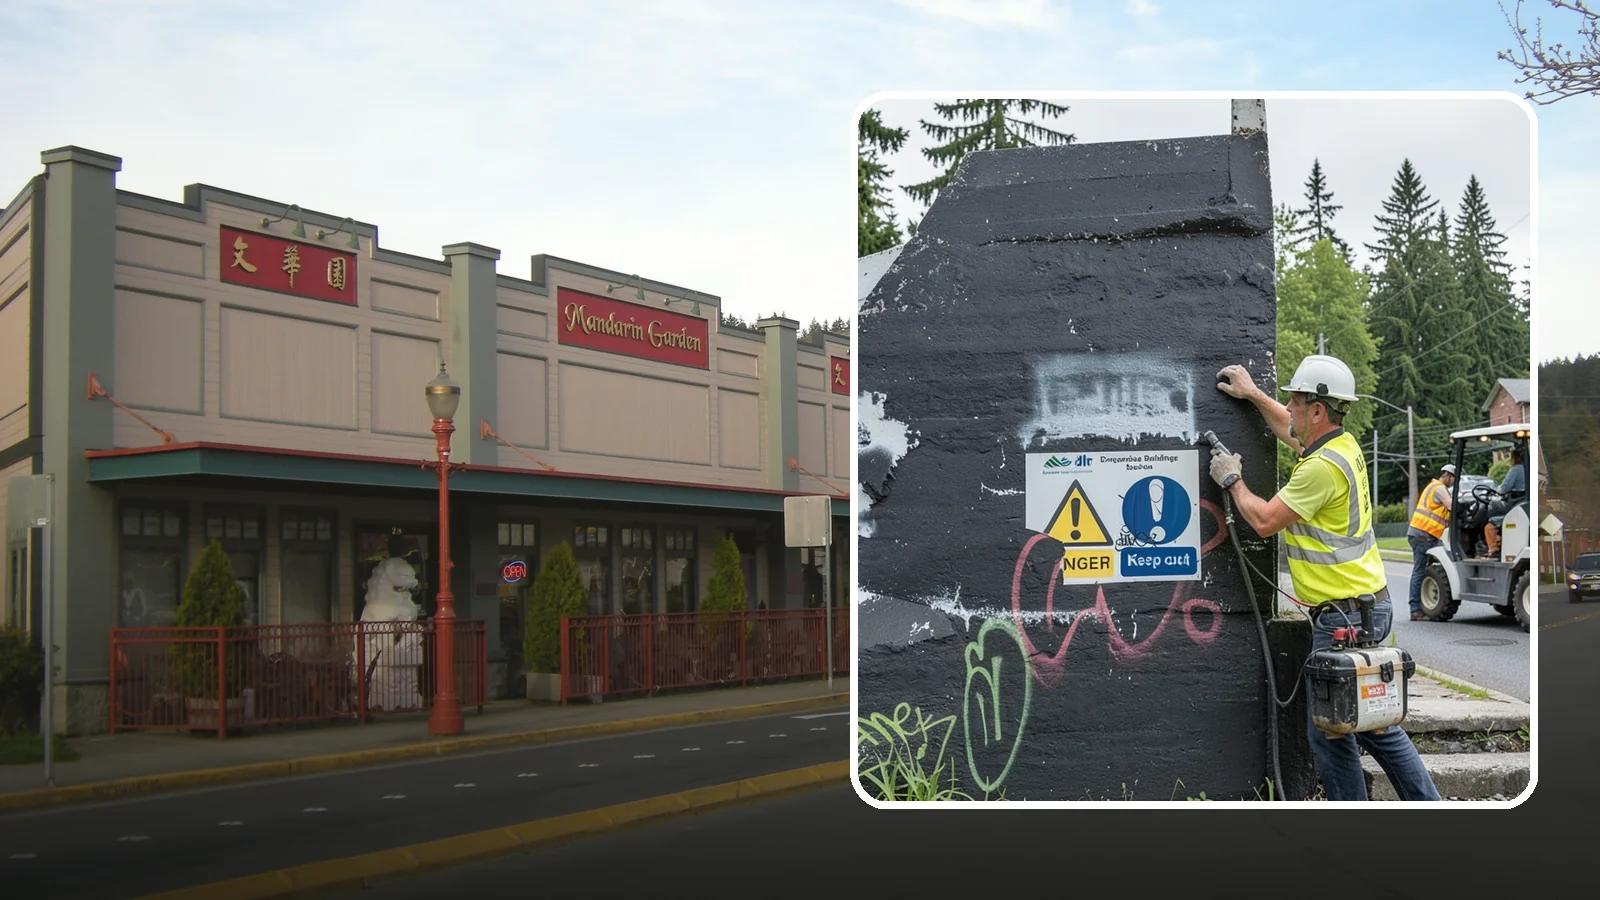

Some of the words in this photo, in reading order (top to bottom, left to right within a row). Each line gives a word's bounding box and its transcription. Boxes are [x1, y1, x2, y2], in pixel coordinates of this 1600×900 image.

[564, 302, 644, 341] Mandarin
[648, 320, 701, 352] Garden
[1063, 556, 1110, 571] NGER
[1127, 553, 1161, 569] Keep
[503, 565, 527, 578] OPEN
